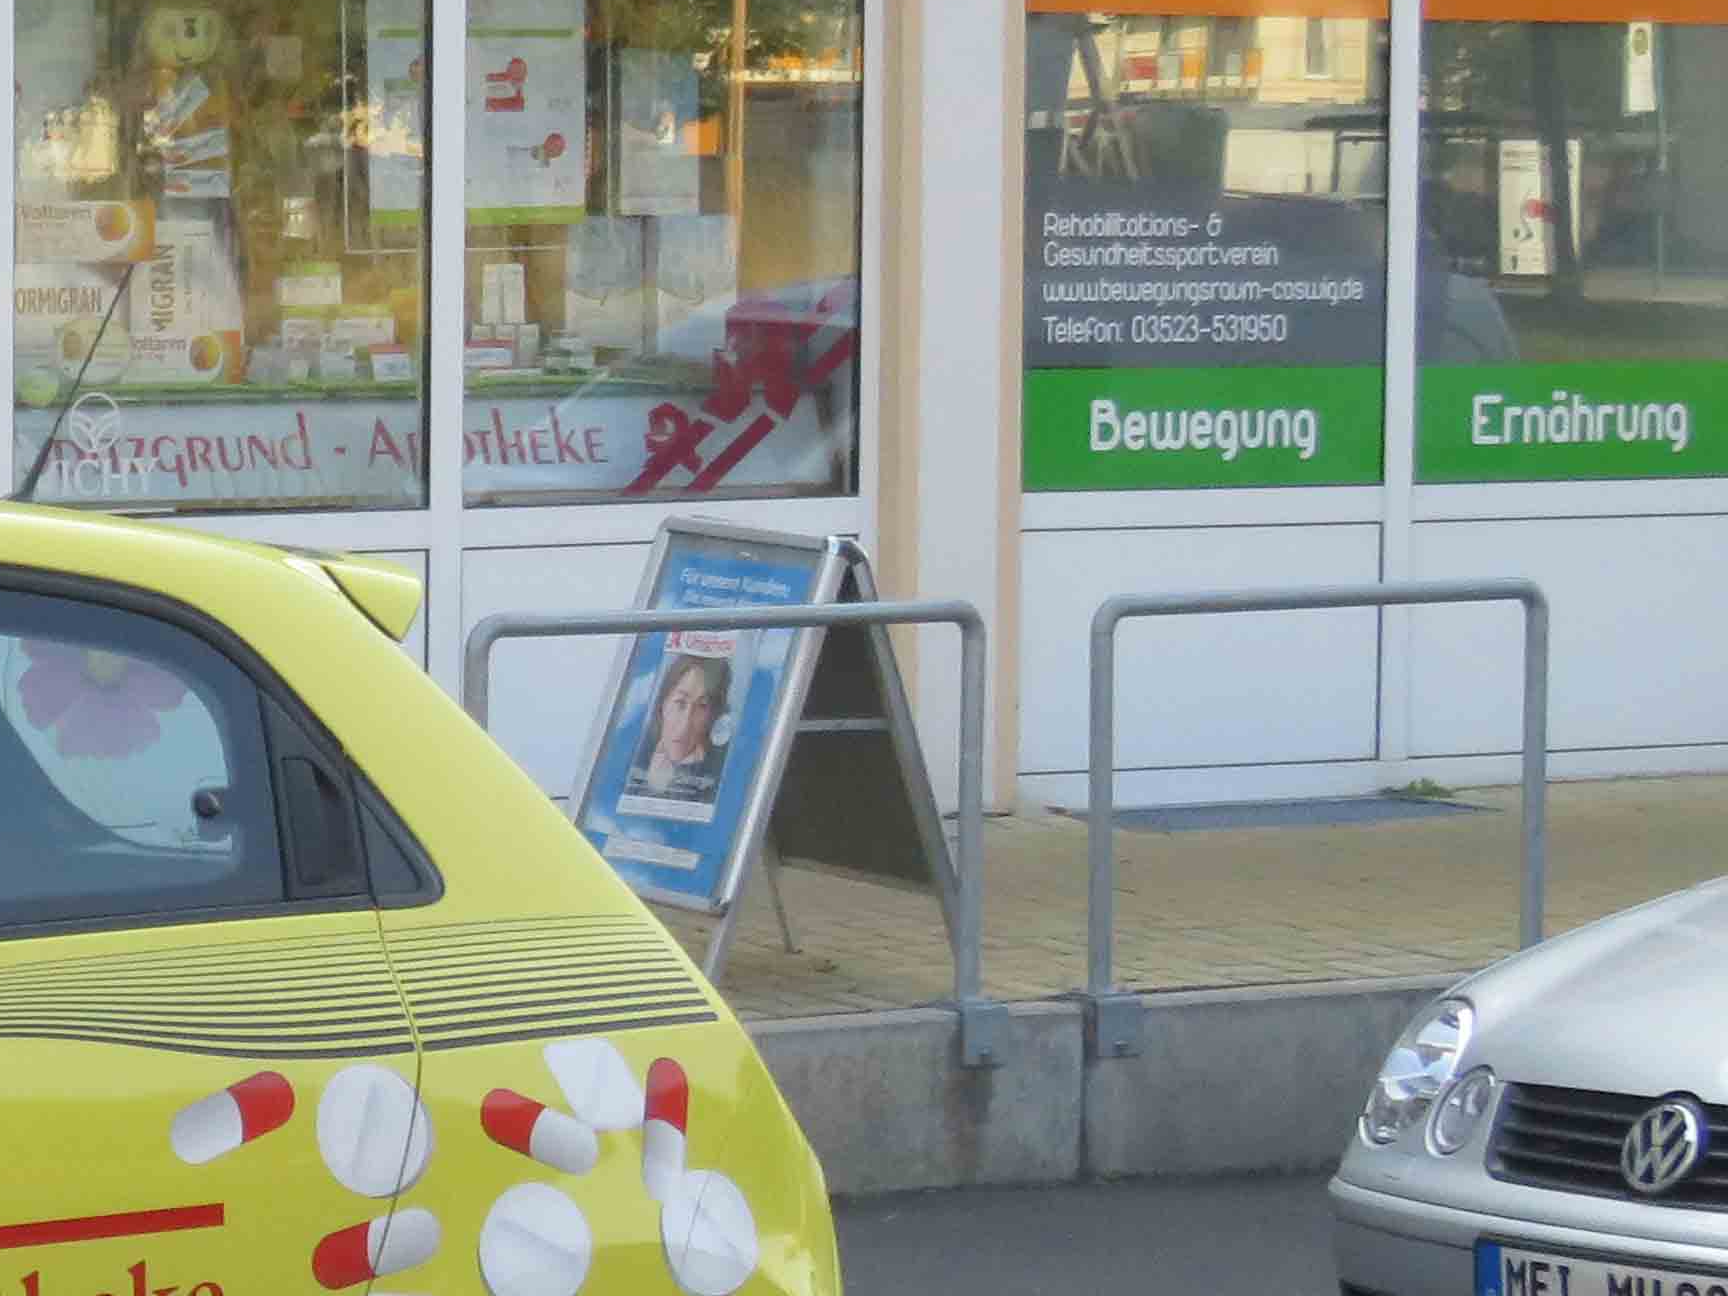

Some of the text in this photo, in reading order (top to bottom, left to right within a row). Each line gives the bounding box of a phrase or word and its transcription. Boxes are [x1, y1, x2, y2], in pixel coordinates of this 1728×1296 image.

[1131, 314, 1288, 343] 03523-531950
[1088, 398, 1320, 462] Bewegung
[1471, 390, 1689, 452] Ernährung
